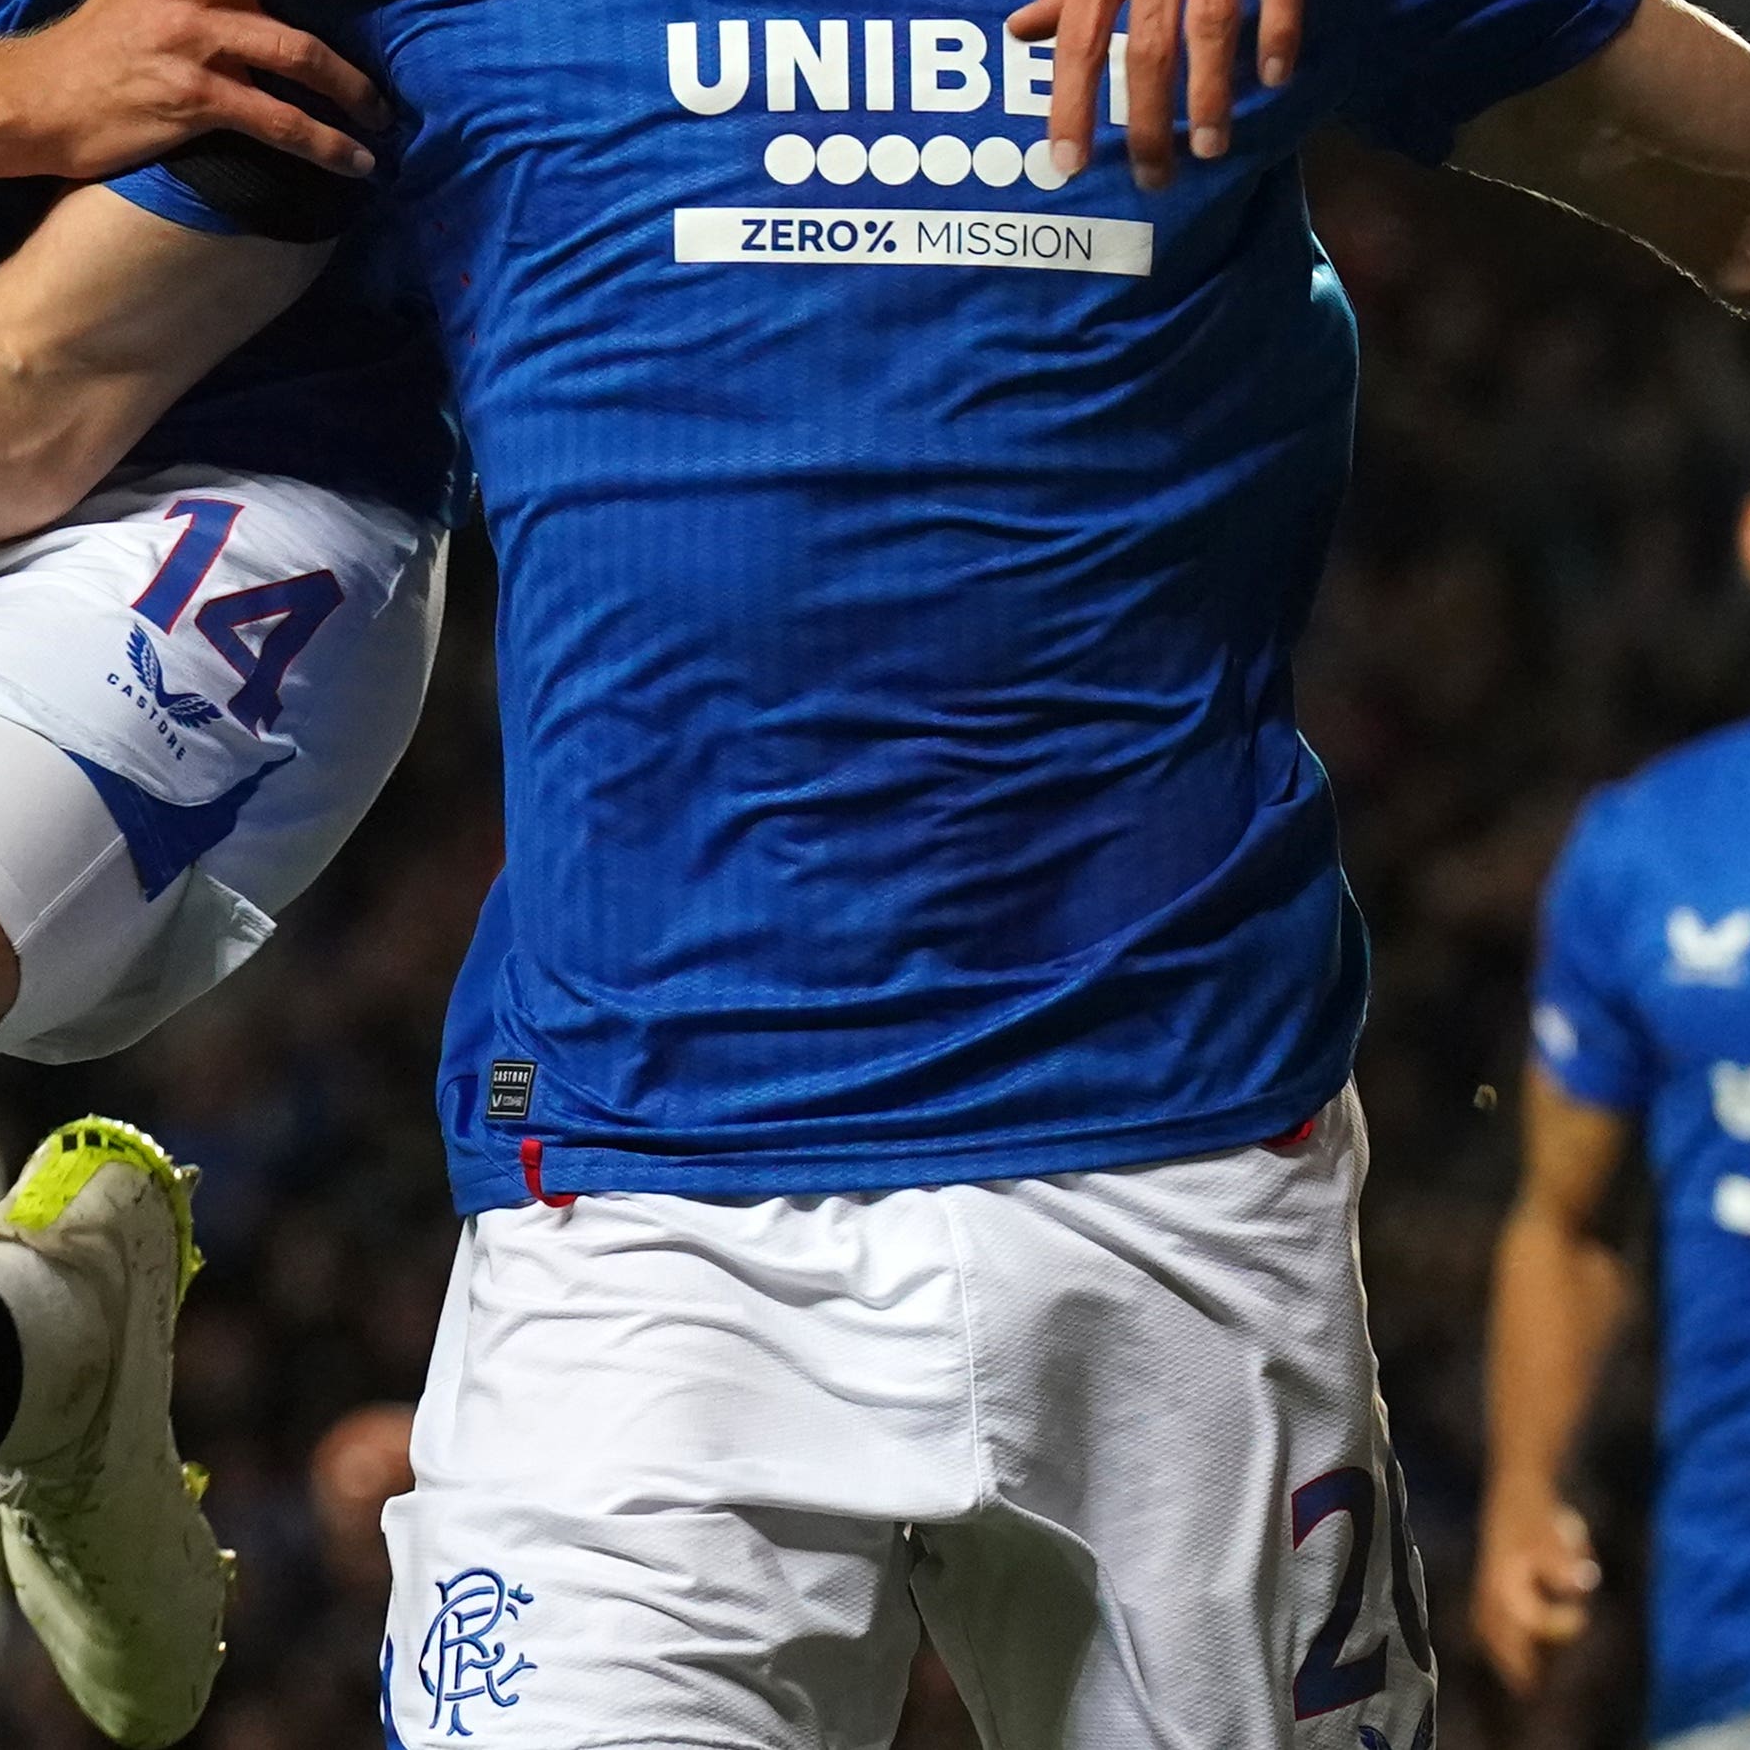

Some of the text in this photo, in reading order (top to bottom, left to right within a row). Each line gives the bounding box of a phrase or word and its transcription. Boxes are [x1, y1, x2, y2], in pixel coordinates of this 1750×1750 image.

[740, 218, 1094, 262] ZERO% MISSION
[130, 498, 346, 741] 14
[106, 672, 187, 761] CASTORE
[493, 1070, 529, 1083] CASTORE
